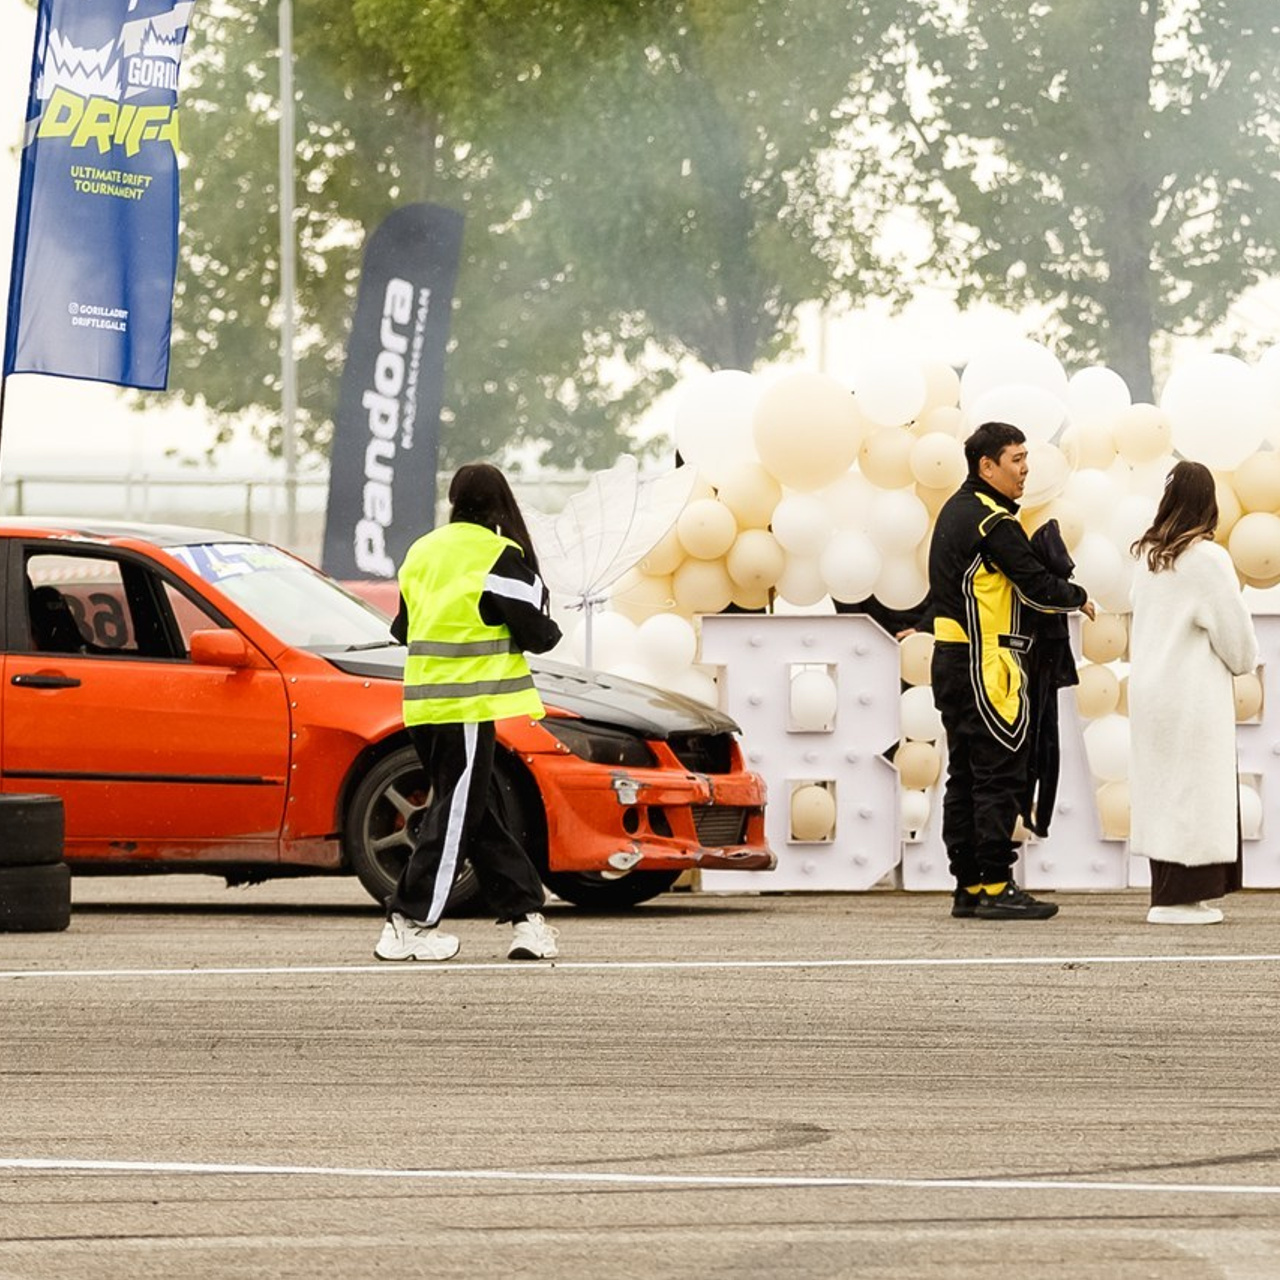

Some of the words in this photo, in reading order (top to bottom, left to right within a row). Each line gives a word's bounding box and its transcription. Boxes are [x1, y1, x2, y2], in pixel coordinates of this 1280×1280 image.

[71, 166, 121, 183] ULTIMATE
[122, 173, 152, 187] DRIFT
[74, 180, 144, 200] TOURNAMENT
[354, 277, 414, 579] Pandora
